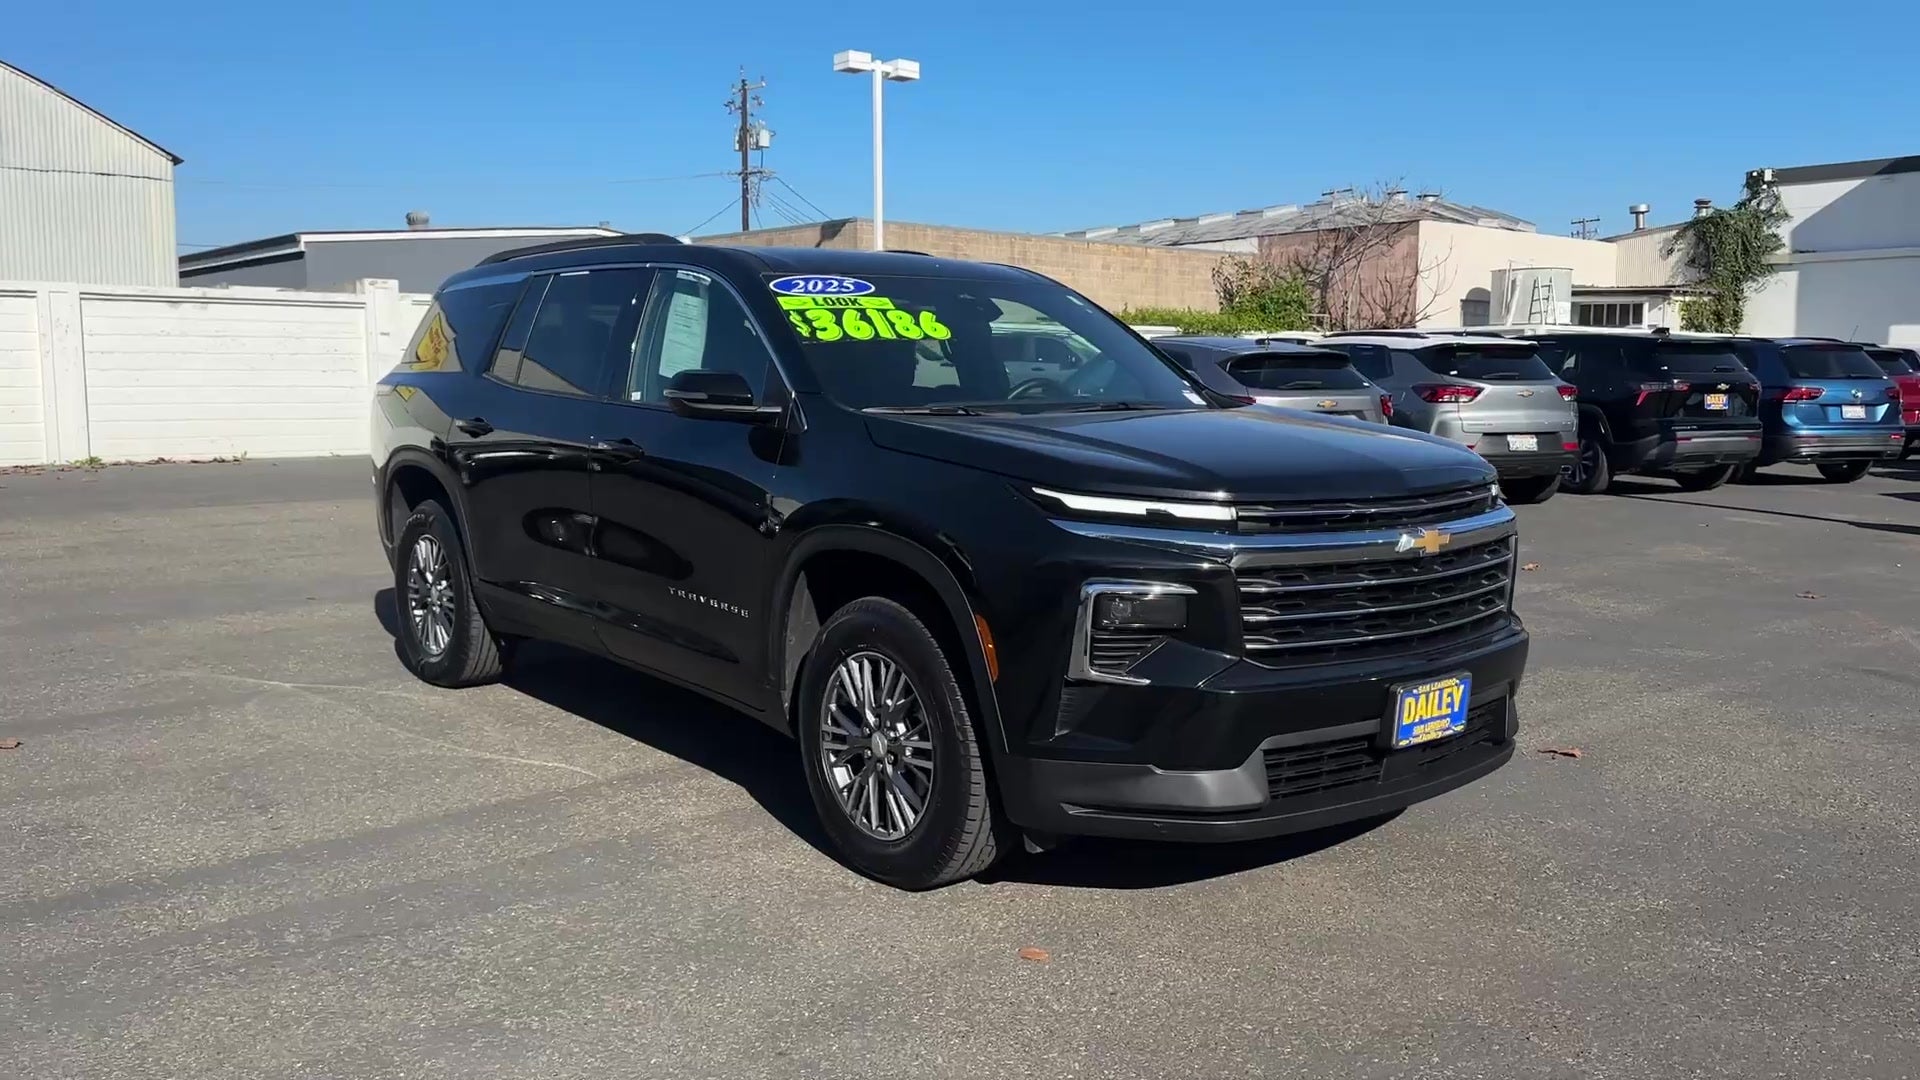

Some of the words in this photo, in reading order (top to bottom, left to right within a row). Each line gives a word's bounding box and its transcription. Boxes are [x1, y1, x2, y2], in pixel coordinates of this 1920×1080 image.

[790, 278, 856, 294] 2025
[811, 297, 863, 308] LOOK
[789, 308, 952, 342] $36186
[667, 586, 749, 618] TRAVERSE
[1403, 684, 1464, 725] DAILEY
